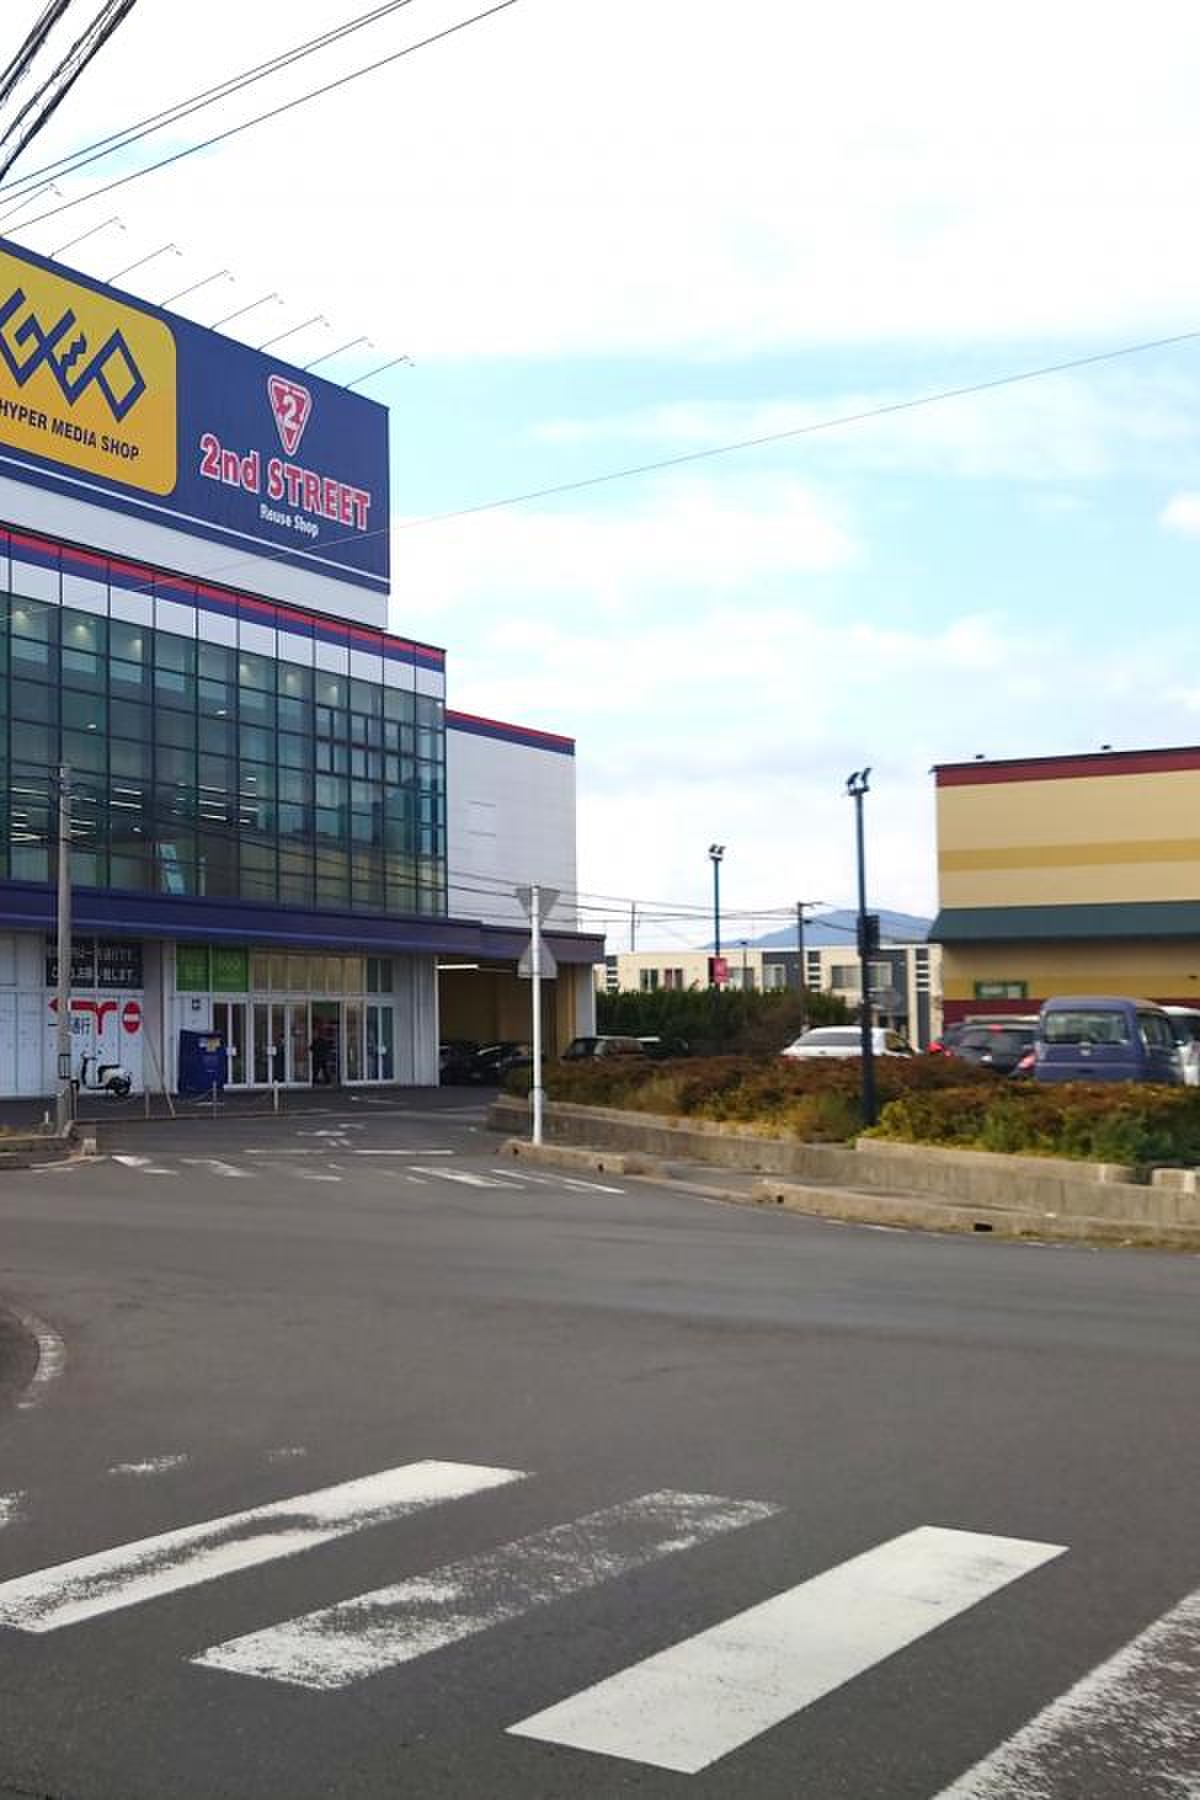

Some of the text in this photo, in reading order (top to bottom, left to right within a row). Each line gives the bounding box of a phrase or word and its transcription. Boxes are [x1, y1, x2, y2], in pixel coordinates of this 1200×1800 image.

[51, 418, 98, 449] MEDIA
[101, 435, 140, 461] SHOP
[200, 432, 371, 531] 2nd STREET
[259, 503, 320, 539] Reuse Shop
